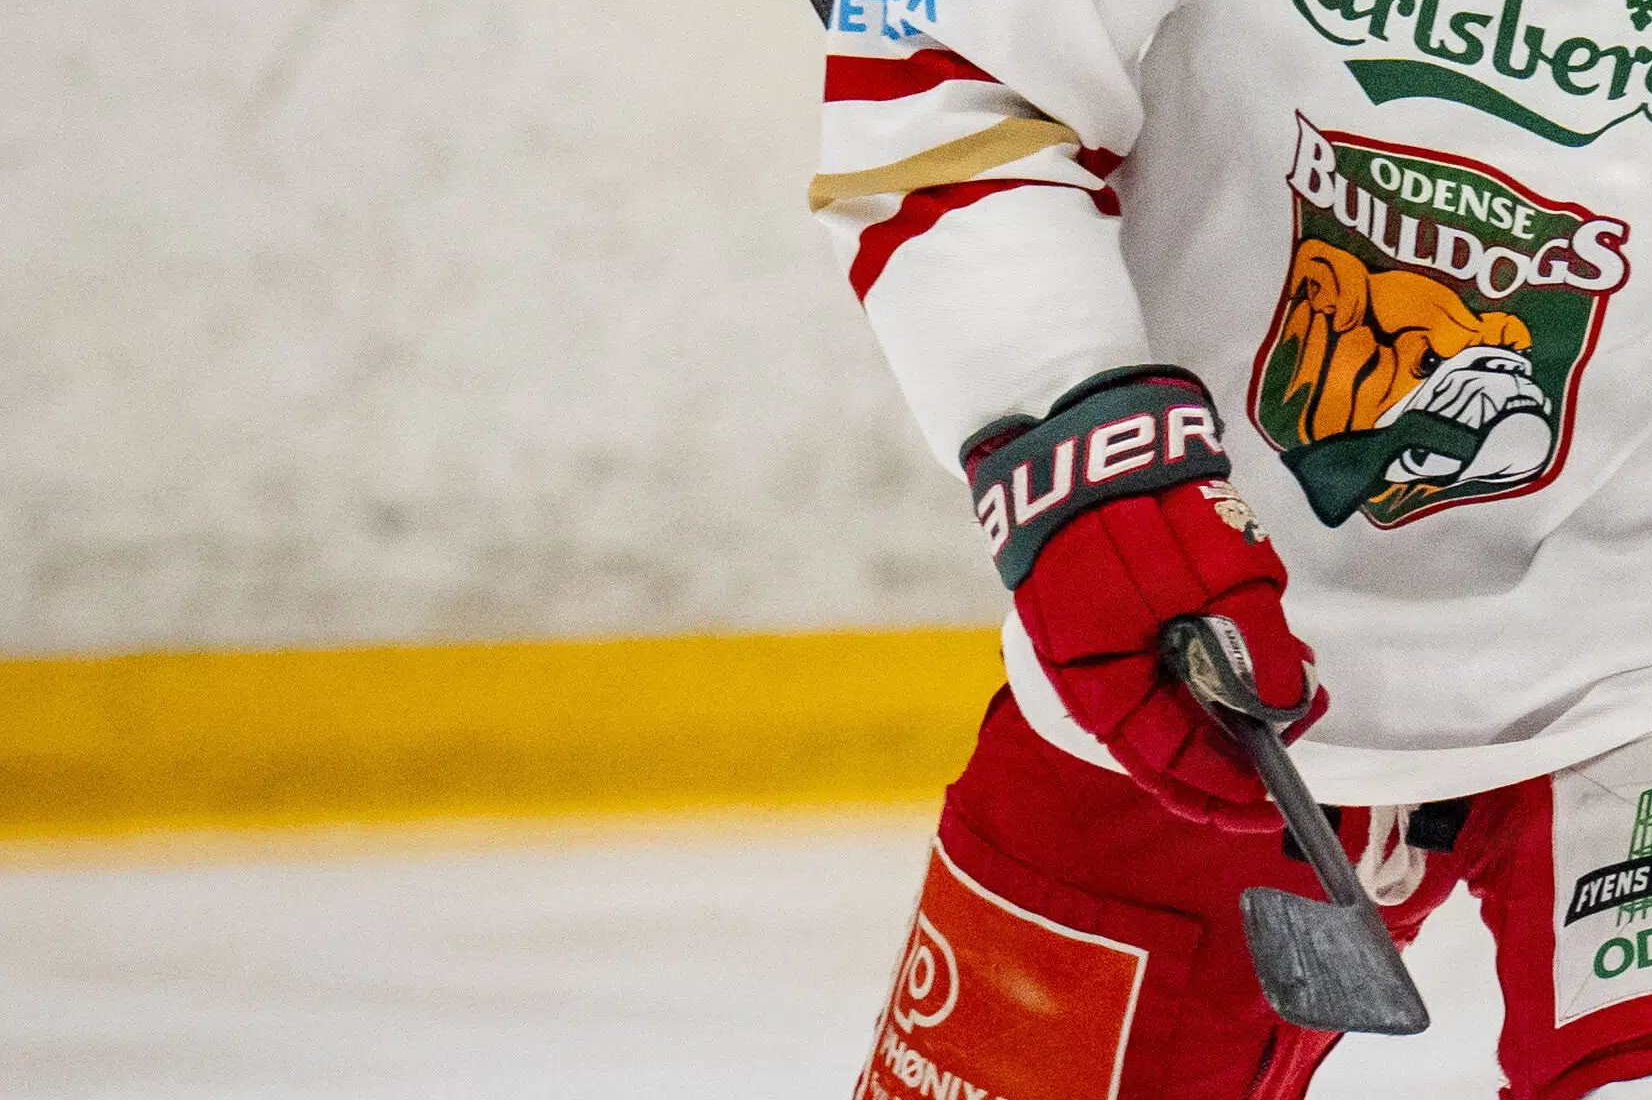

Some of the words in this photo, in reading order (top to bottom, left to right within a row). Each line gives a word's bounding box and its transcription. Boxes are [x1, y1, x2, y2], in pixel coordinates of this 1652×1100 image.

[1287, 109, 1632, 300] BULLDOGS
[1369, 156, 1537, 240] ODENSE
[1574, 865, 1651, 914] FYENS
